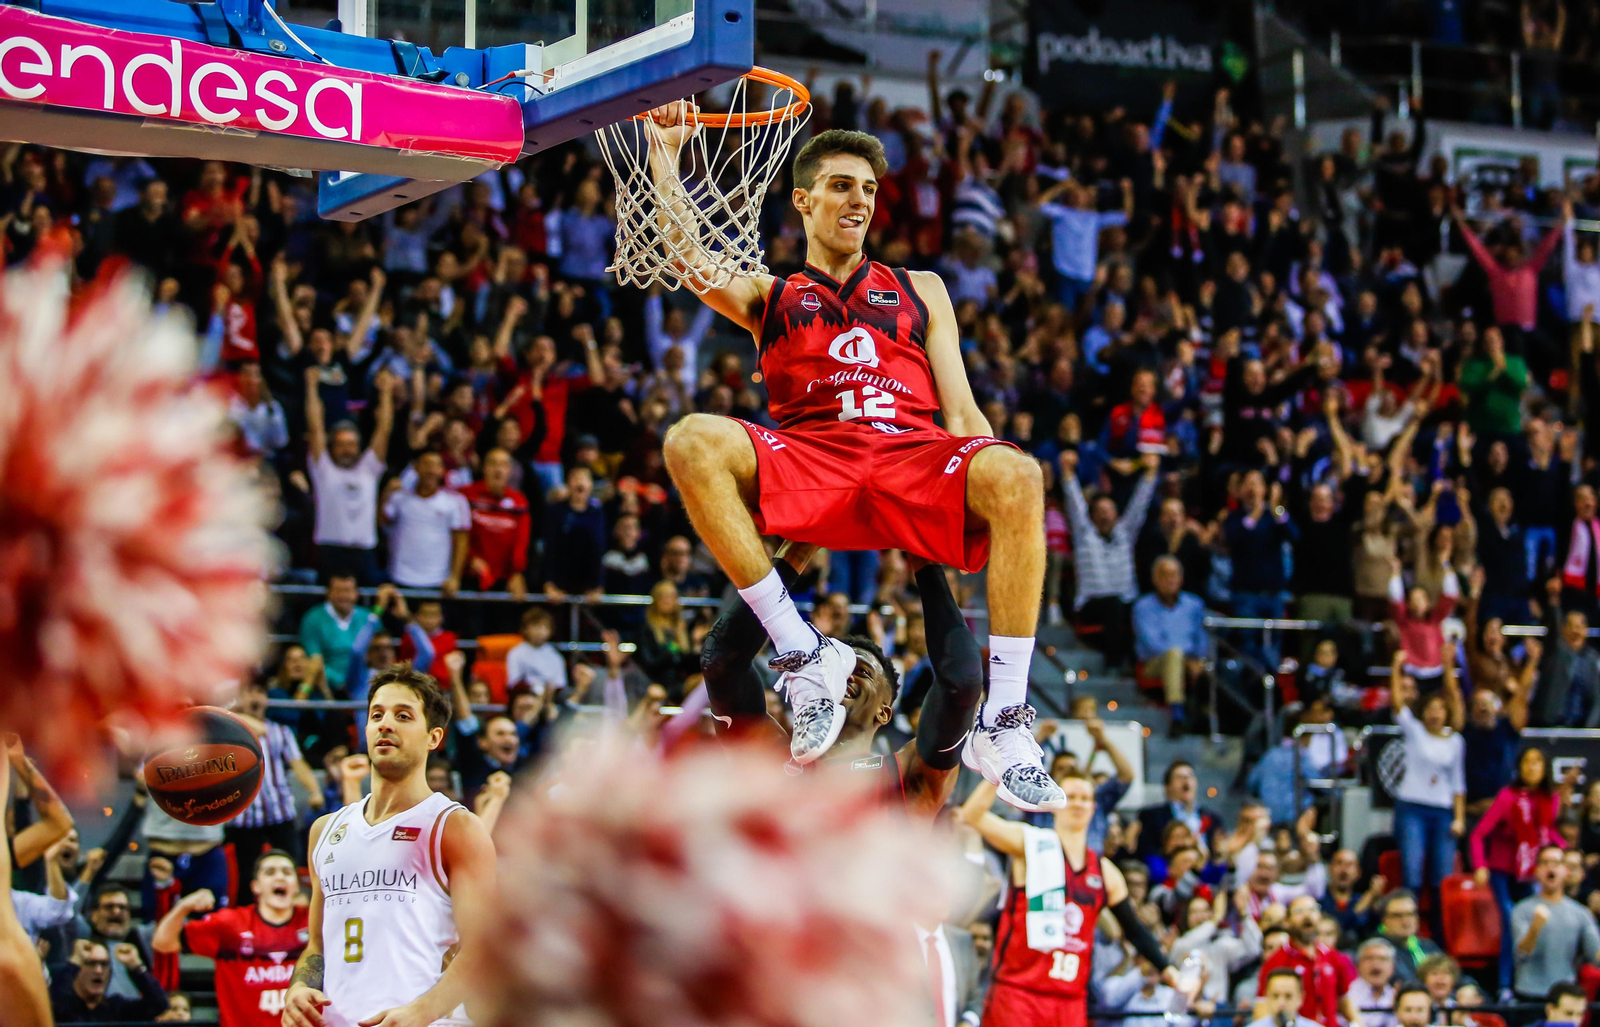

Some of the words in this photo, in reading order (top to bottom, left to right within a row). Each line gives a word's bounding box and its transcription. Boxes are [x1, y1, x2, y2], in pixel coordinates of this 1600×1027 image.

[1037, 27, 1213, 75] podoactiva
[0, 36, 363, 141] endesa
[835, 385, 896, 422] 12
[157, 752, 237, 785] SPALDING
[362, 893, 416, 904] GROUP
[344, 917, 363, 963] 8
[1048, 950, 1080, 982] 19
